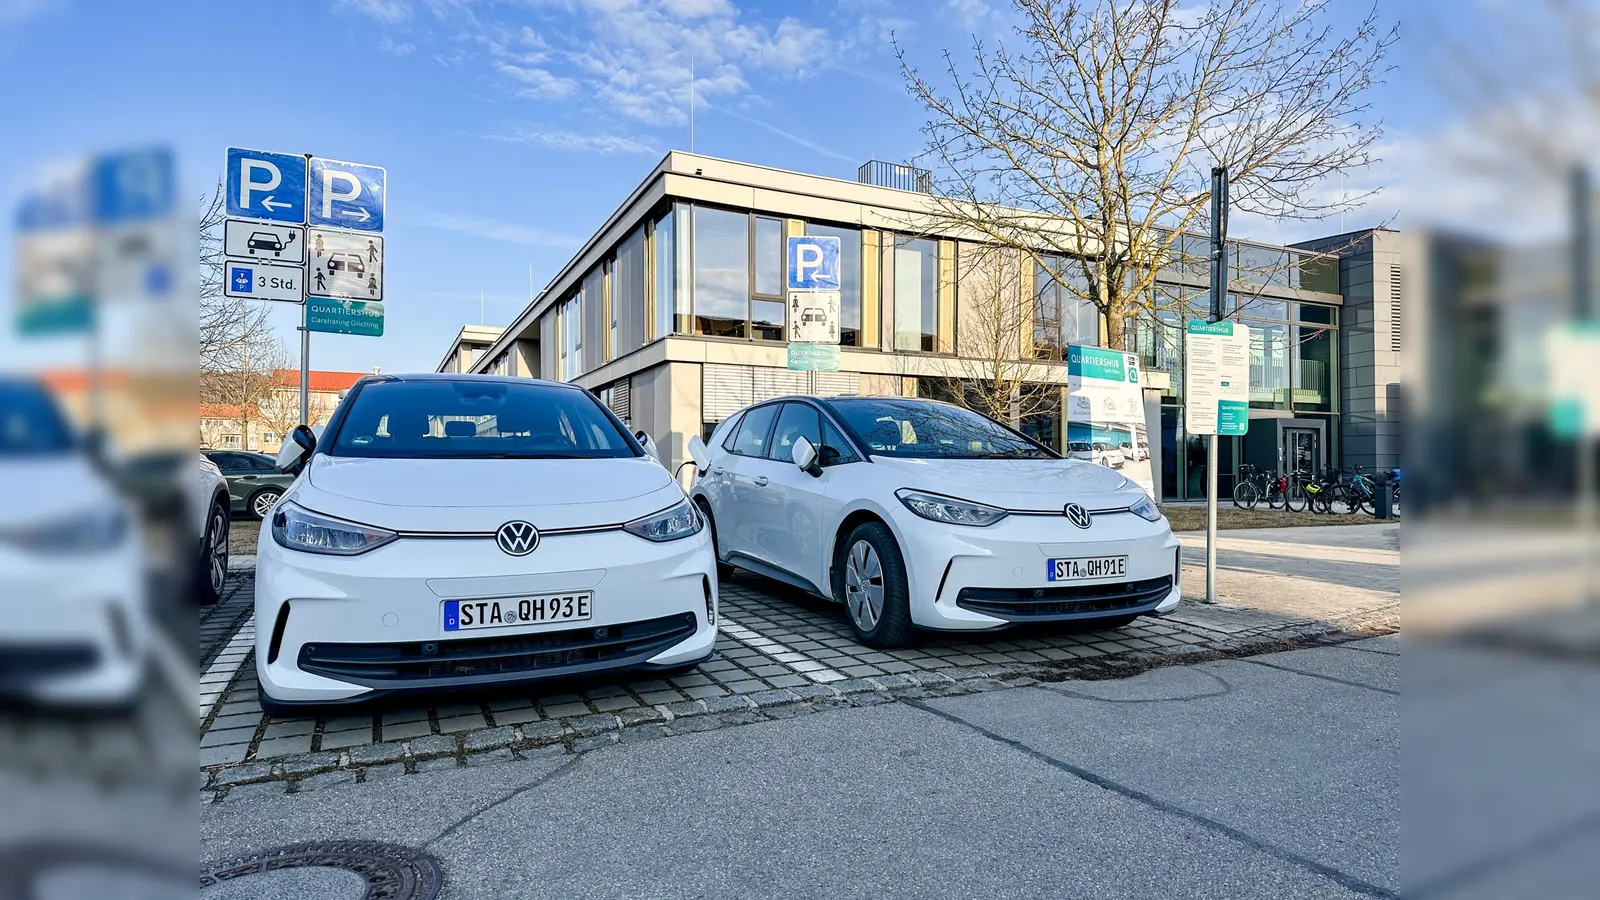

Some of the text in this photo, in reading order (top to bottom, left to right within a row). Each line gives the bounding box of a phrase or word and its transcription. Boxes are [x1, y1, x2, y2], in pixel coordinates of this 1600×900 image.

[239, 157, 282, 209] P
[322, 168, 362, 219] P
[796, 243, 824, 283] P
[258, 276, 297, 291] 3 Std.
[311, 305, 380, 318] QUARTIERSHUB
[311, 316, 380, 329] Carsharing Gilching
[1071, 354, 1120, 368] QUARTIERSHUB
[1056, 561, 1080, 578] STA
[460, 601, 503, 626] STA
